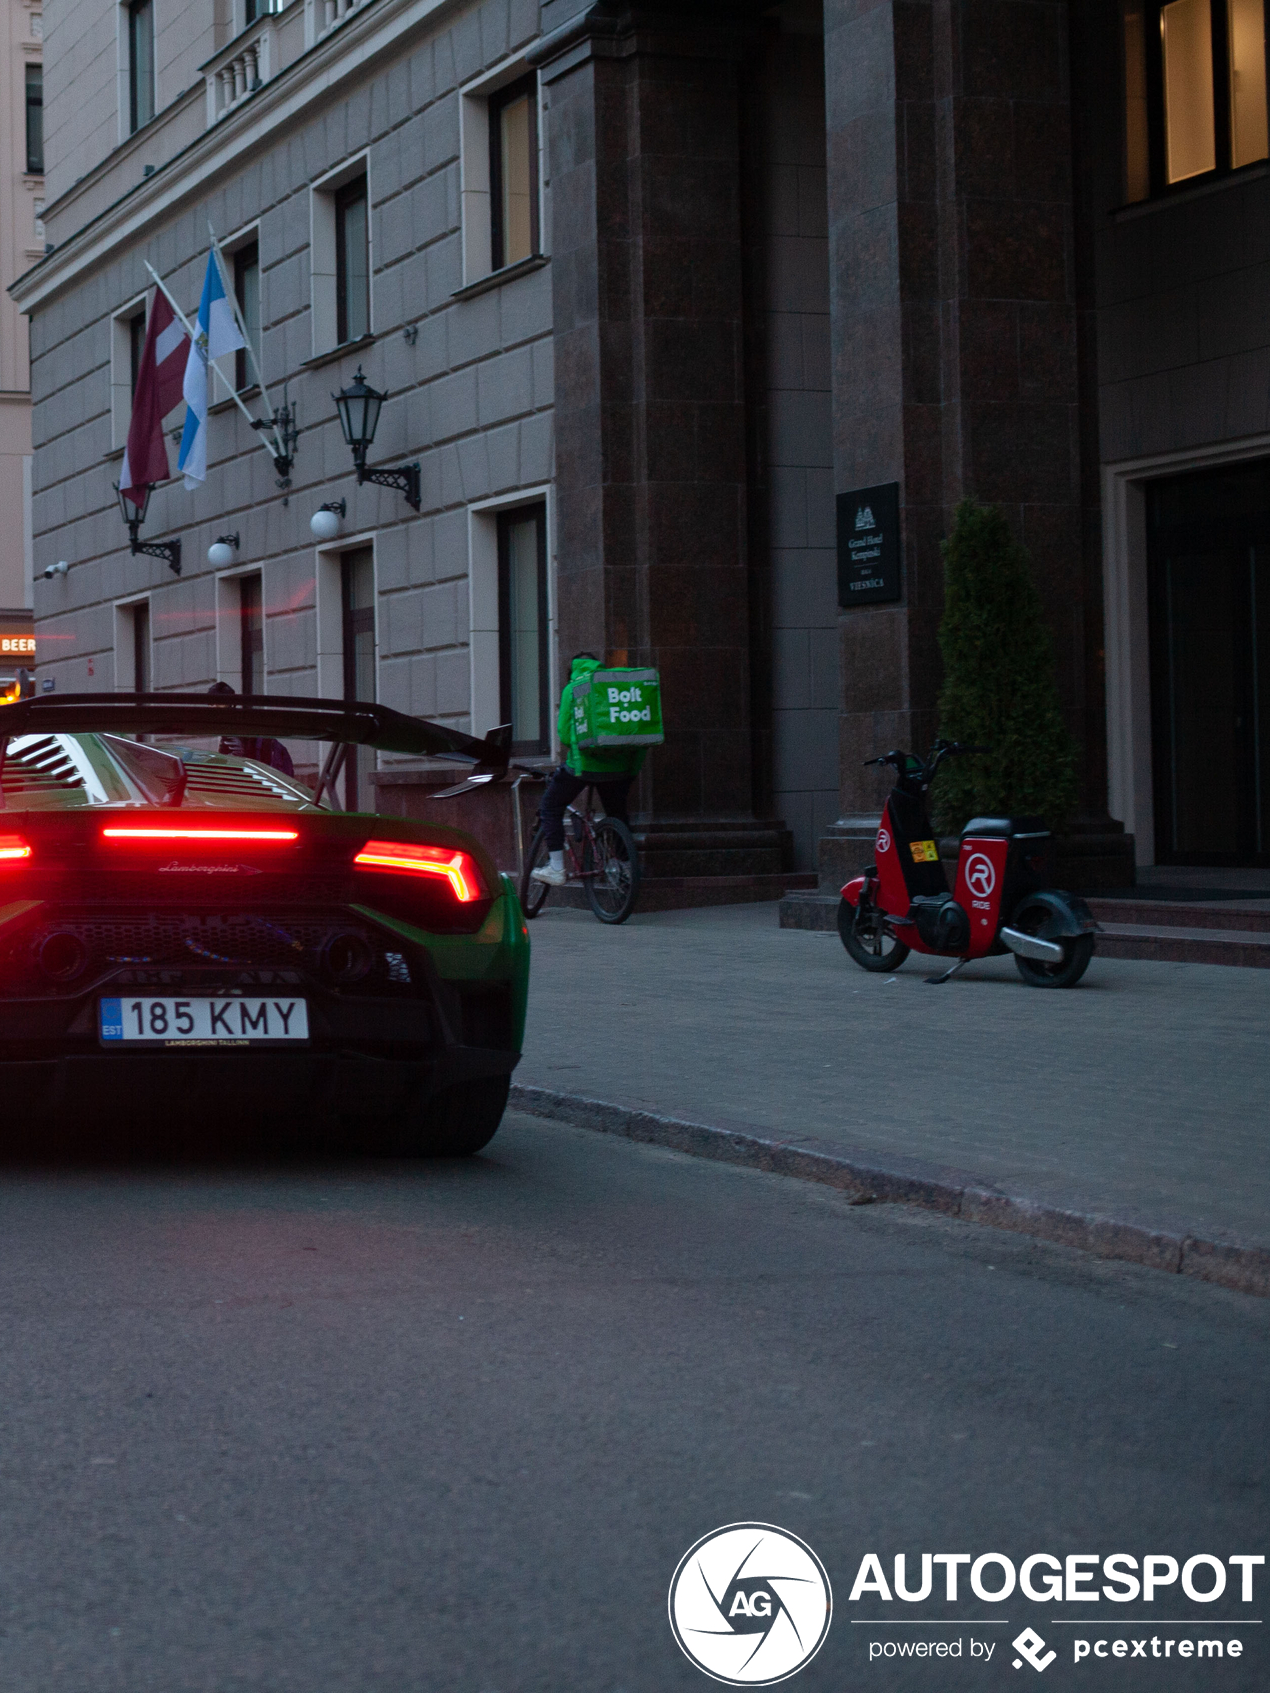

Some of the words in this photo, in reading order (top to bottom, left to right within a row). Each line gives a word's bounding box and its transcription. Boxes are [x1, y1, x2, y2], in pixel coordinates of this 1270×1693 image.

[1, 639, 36, 651] BEER
[607, 687, 642, 704] Bolt
[609, 705, 651, 723] Food
[158, 861, 239, 875] Lamborghini
[971, 900, 991, 910] RIDE
[130, 1001, 194, 1035] 185
[209, 1001, 296, 1036] KMY
[102, 1025, 123, 1035] EST
